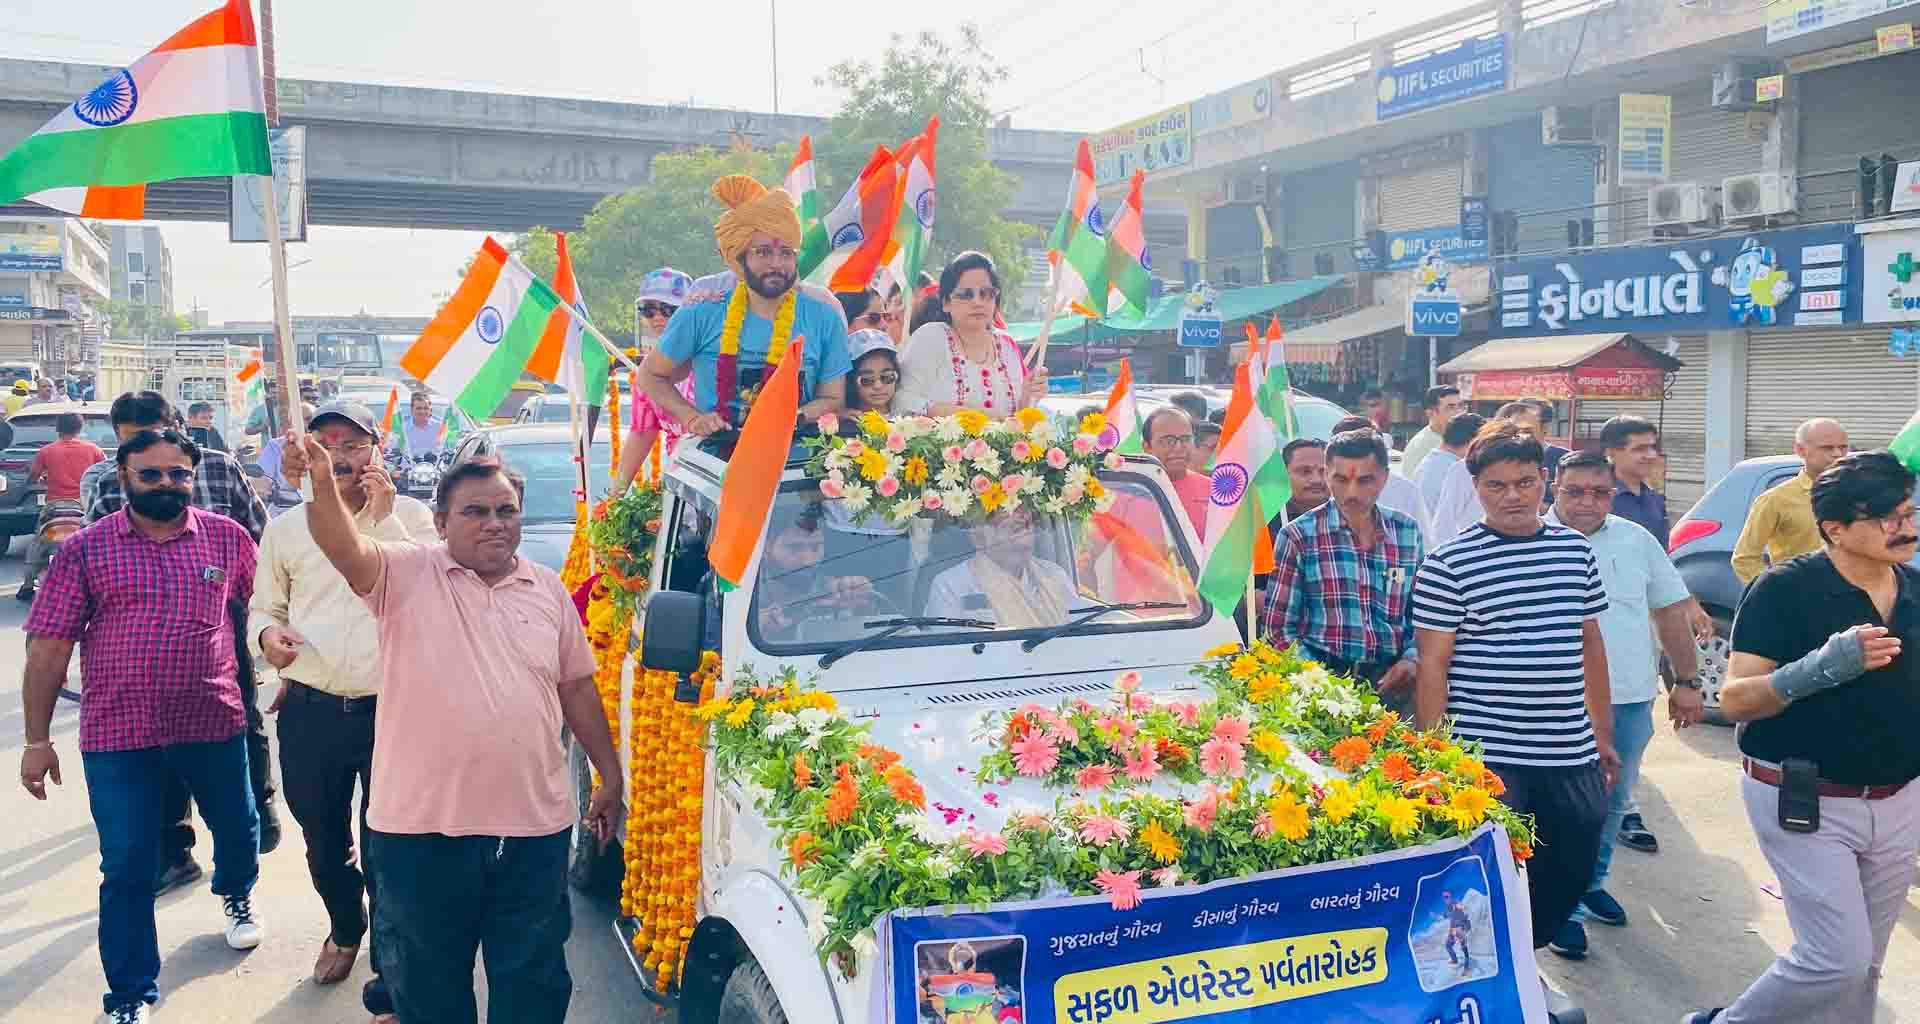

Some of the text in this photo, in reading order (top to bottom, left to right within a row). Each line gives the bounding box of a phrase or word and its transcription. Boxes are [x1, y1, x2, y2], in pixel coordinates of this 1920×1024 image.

[1430, 53, 1503, 88] SECURITIES
[1415, 307, 1458, 324] vivo
[1183, 326, 1220, 338] vivo
[1310, 882, 1400, 911] ભારતનું ગૌરવ
[1193, 897, 1280, 928] ડીસાનું ગૌરવ
[1050, 919, 1162, 956] ગુજરાતનું ગૌરવ
[1067, 939, 1378, 1024] સફળ એવરેસ્ટ પર્વતારોહક
